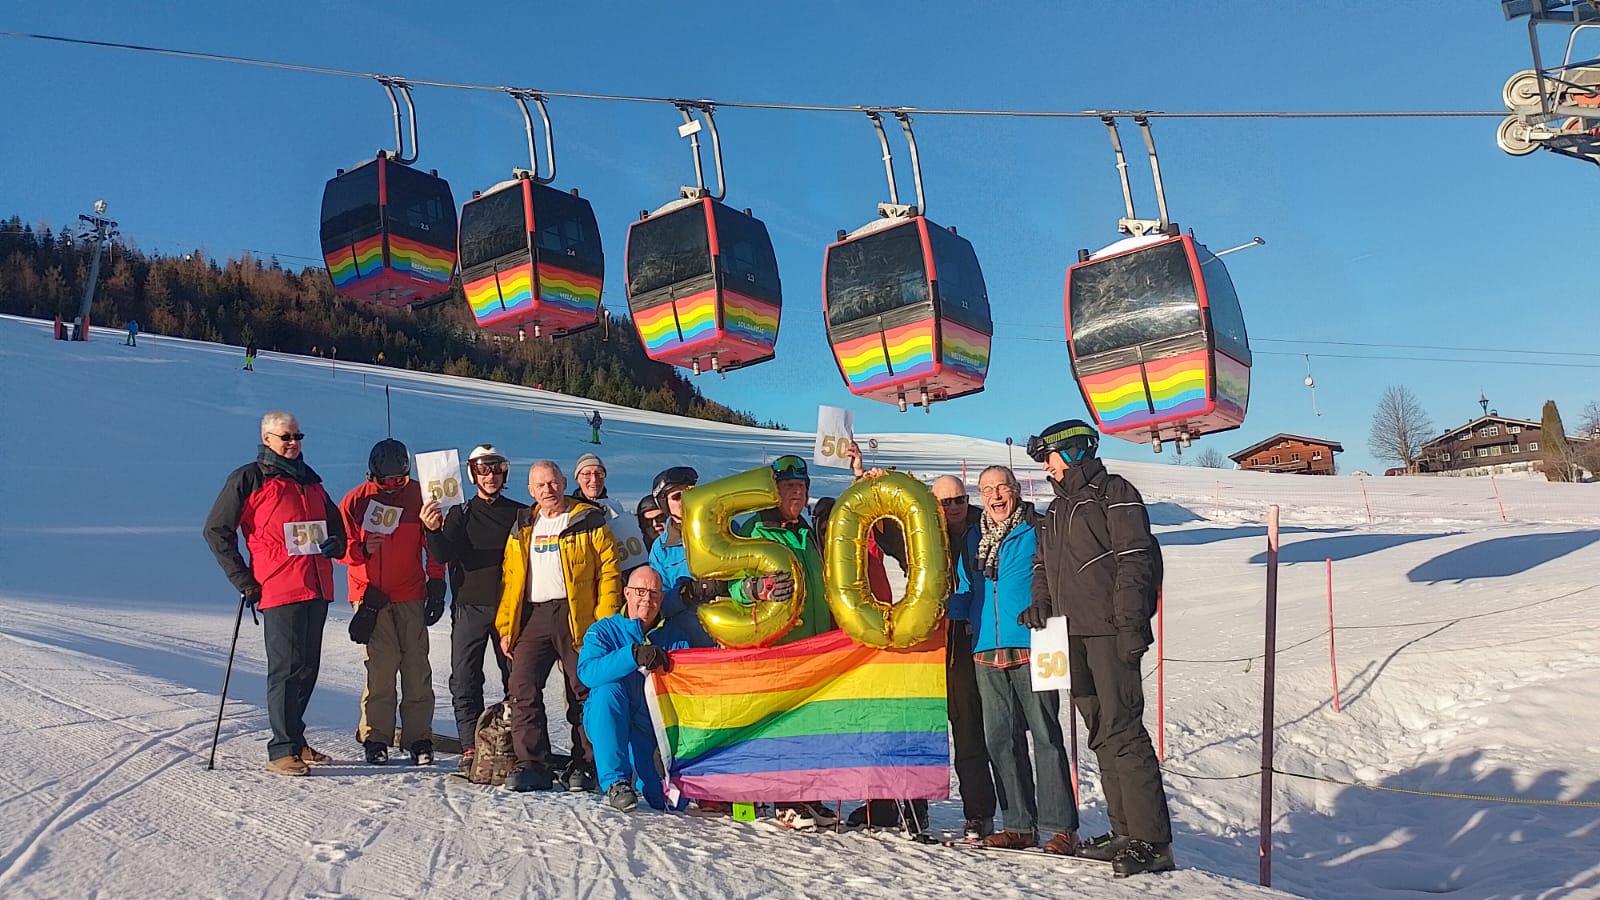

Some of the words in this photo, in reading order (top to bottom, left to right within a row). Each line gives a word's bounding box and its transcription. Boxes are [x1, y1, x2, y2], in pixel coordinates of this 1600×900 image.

[820, 435, 850, 462] 50
[427, 477, 459, 500] 50
[370, 505, 398, 528] 50
[292, 523, 325, 546] 50
[534, 534, 559, 553] 50
[617, 536, 642, 560] 50
[682, 464, 952, 649] 50
[1037, 651, 1067, 679] 50
